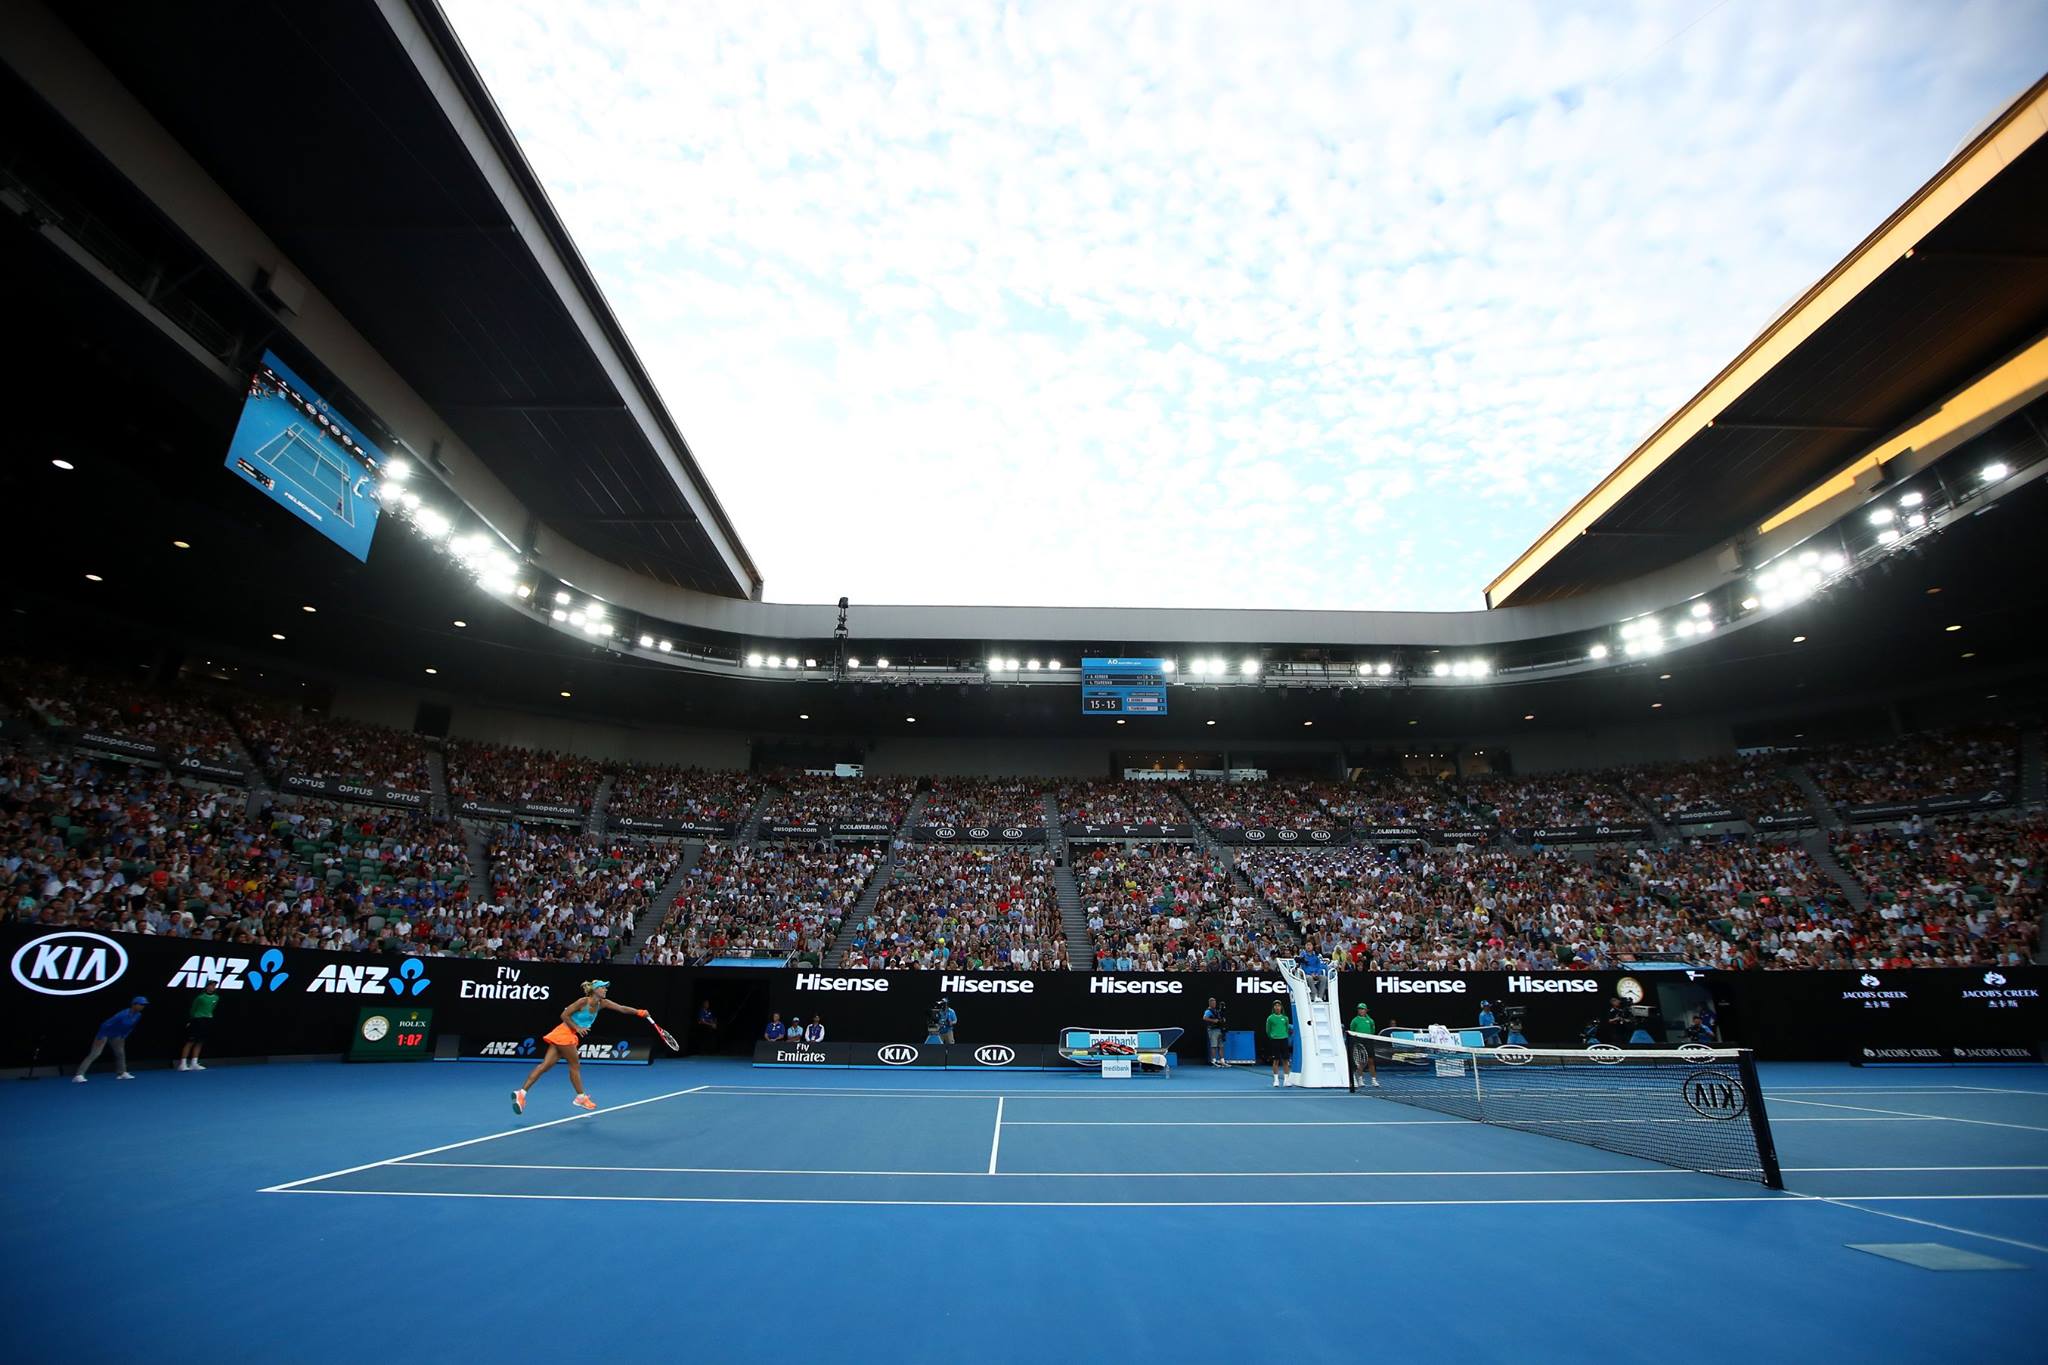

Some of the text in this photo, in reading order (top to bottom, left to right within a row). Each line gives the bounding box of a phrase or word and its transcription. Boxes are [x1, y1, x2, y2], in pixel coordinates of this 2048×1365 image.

[83, 733, 157, 753] ausopen.com
[289, 776, 326, 789] OPTUS
[338, 784, 374, 796] OPTUS
[386, 791, 421, 803] OPTUS
[526, 803, 575, 814] ausopen.com
[30, 944, 106, 981] KIA
[167, 955, 250, 990] ANZ
[306, 964, 389, 994] ANZ
[497, 966, 521, 982] Fly
[460, 980, 550, 1000] Emirates
[796, 973, 889, 992] Hisense
[941, 975, 1034, 993] Hisense
[1090, 976, 1183, 994] Hisense
[1236, 977, 1290, 994] Hise
[1376, 976, 1466, 994] Hisense
[1508, 976, 1598, 993] Hisense
[2003, 989, 2039, 997] CREEK
[397, 1034, 423, 1046] 1:07
[480, 1041, 519, 1055] ANZ
[796, 1042, 810, 1051] Fly
[777, 1050, 826, 1062] Emirates
